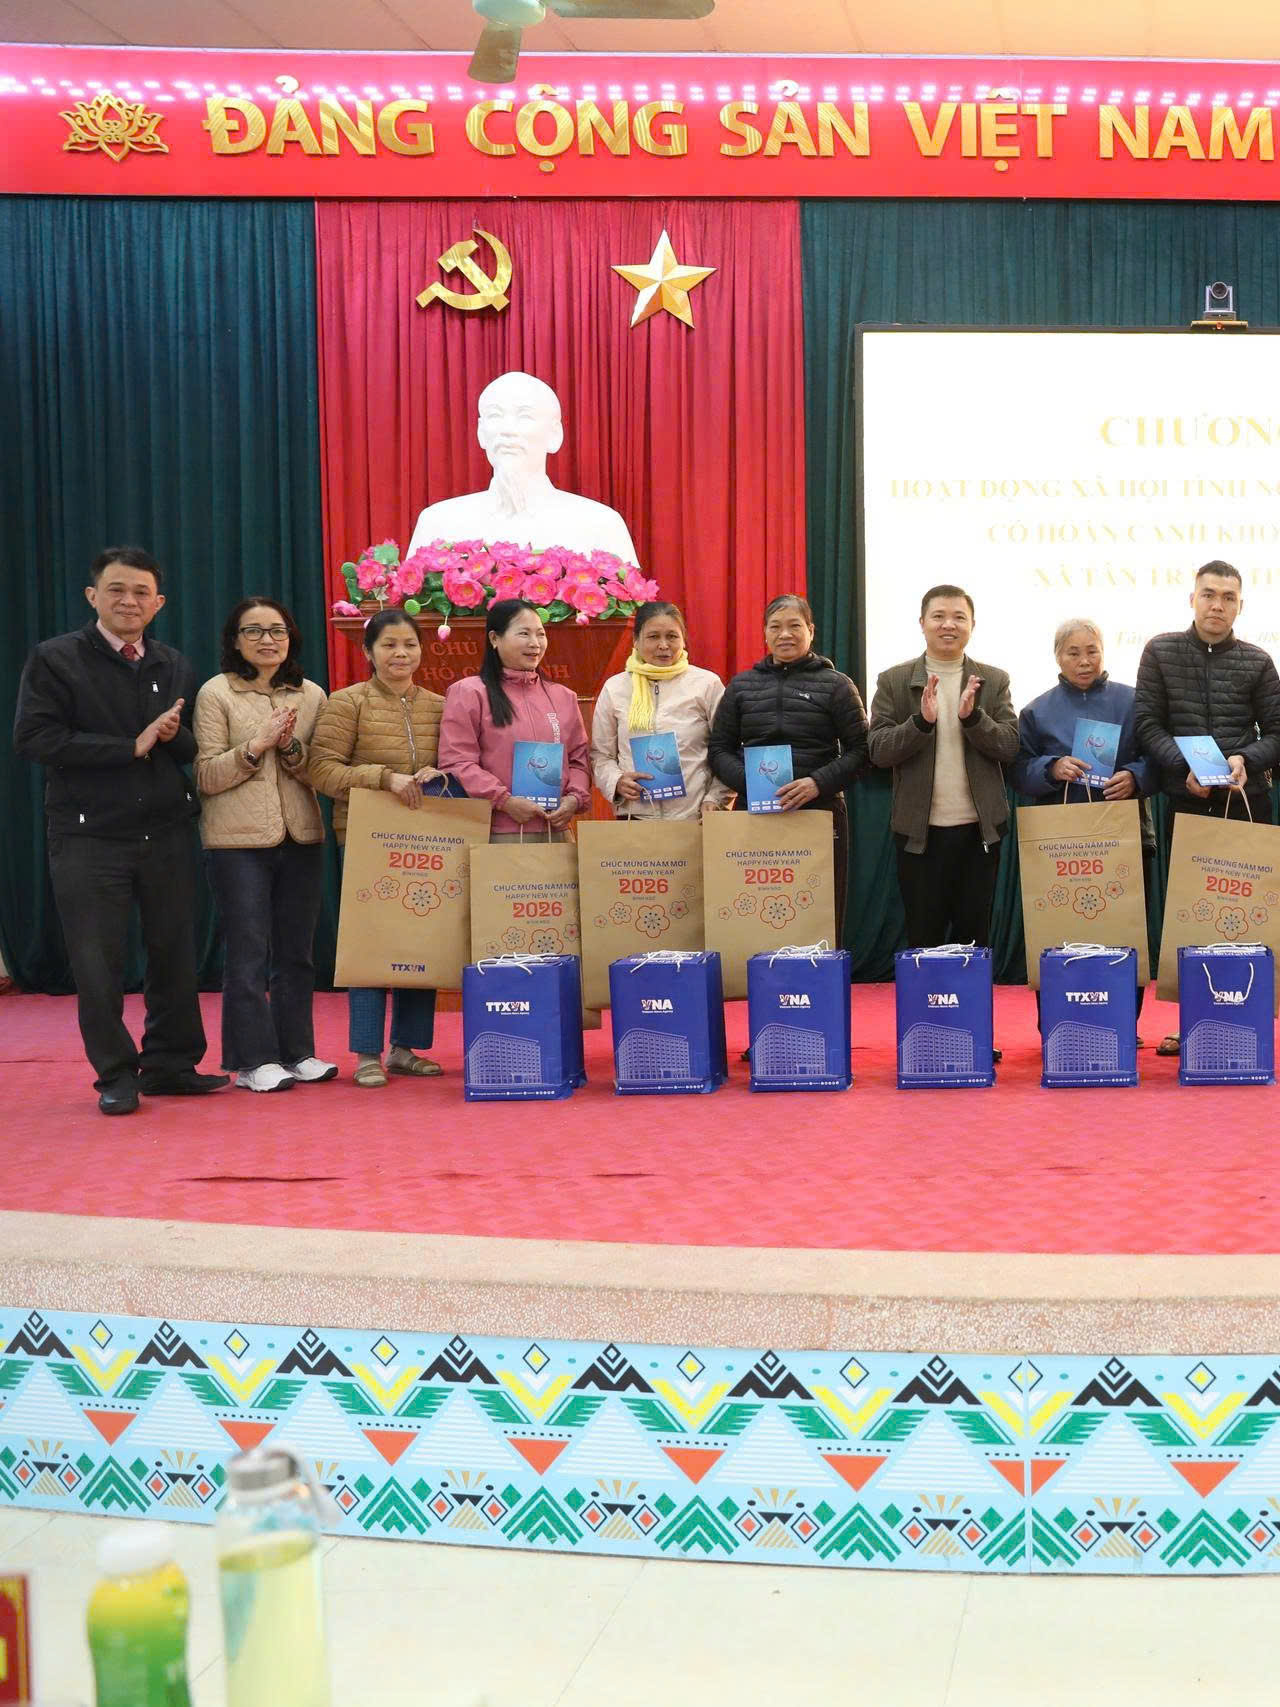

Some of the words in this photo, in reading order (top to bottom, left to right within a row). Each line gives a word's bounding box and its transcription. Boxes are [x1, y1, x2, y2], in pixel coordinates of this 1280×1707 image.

[202, 75, 435, 157] ĐẢNG
[465, 84, 688, 173] CỘNG
[719, 80, 870, 158] SẢN
[903, 87, 1067, 172] VIỆT
[1098, 105, 1275, 161] NAM
[388, 851, 444, 871] 2026
[1056, 859, 1104, 877] 2026
[744, 867, 794, 885] 2026
[618, 878, 669, 894] 2026
[1206, 875, 1253, 897] 2026
[512, 901, 563, 918] 2026
[641, 999, 673, 1010] VNA
[779, 994, 811, 1006] VNA
[927, 993, 959, 1005] VNA
[1065, 991, 1108, 1002] TTXVN
[485, 1001, 530, 1012] TTXVN
